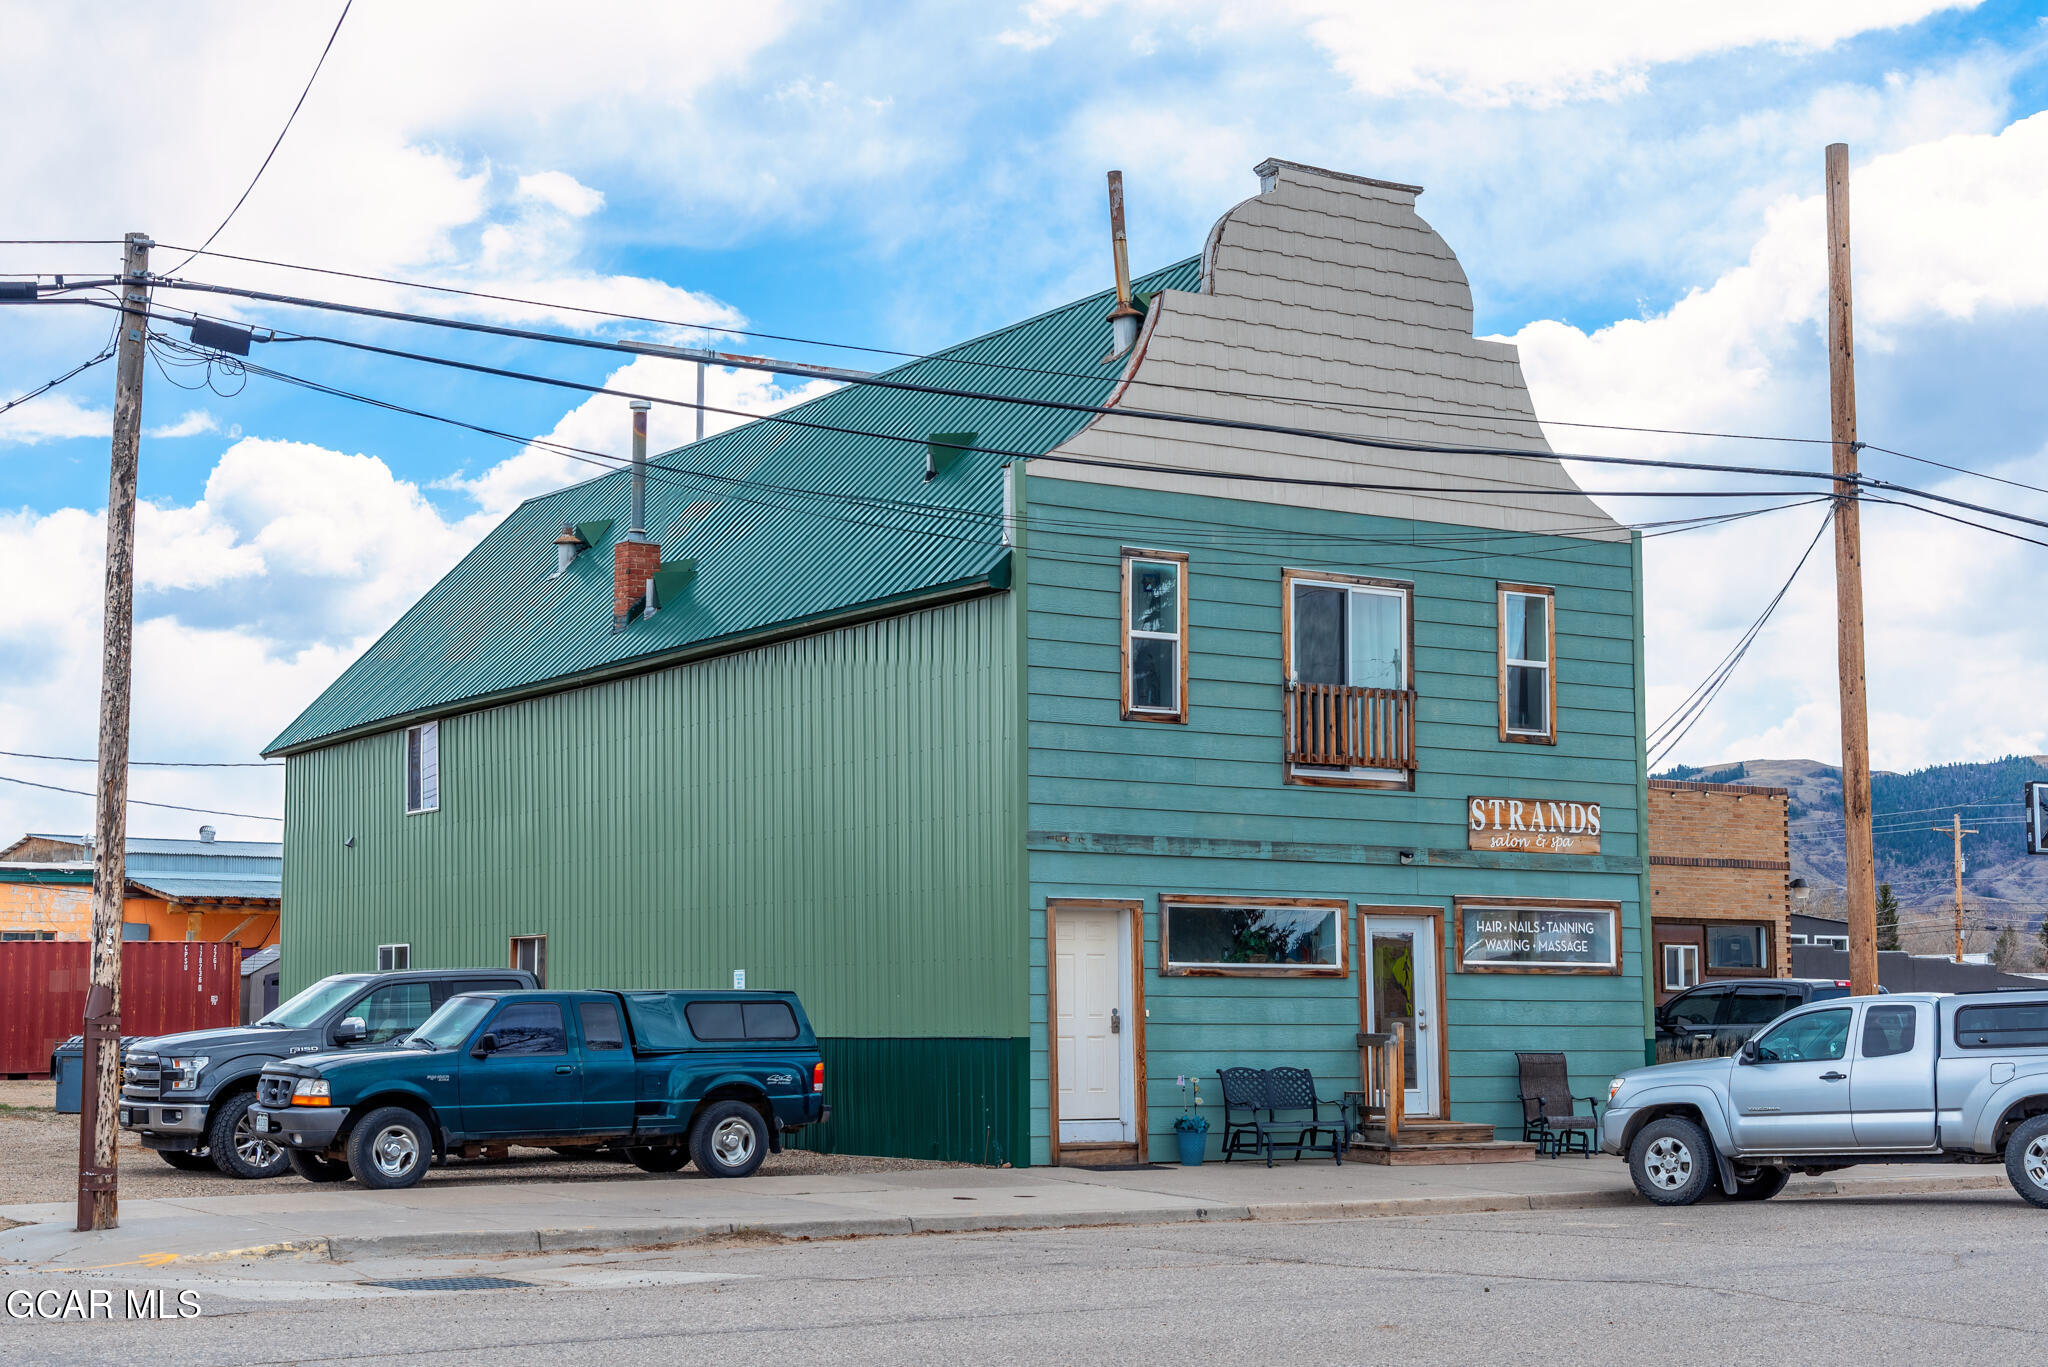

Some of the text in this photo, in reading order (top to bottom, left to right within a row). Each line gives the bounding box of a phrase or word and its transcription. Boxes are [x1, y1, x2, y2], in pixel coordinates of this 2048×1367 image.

[1471, 799, 1601, 836] STRANDS
[1490, 832, 1574, 852] salon & spa
[1476, 920, 1594, 934] HAIR NAILS TANNING
[1485, 939, 1588, 952] WAXING MASSAGE
